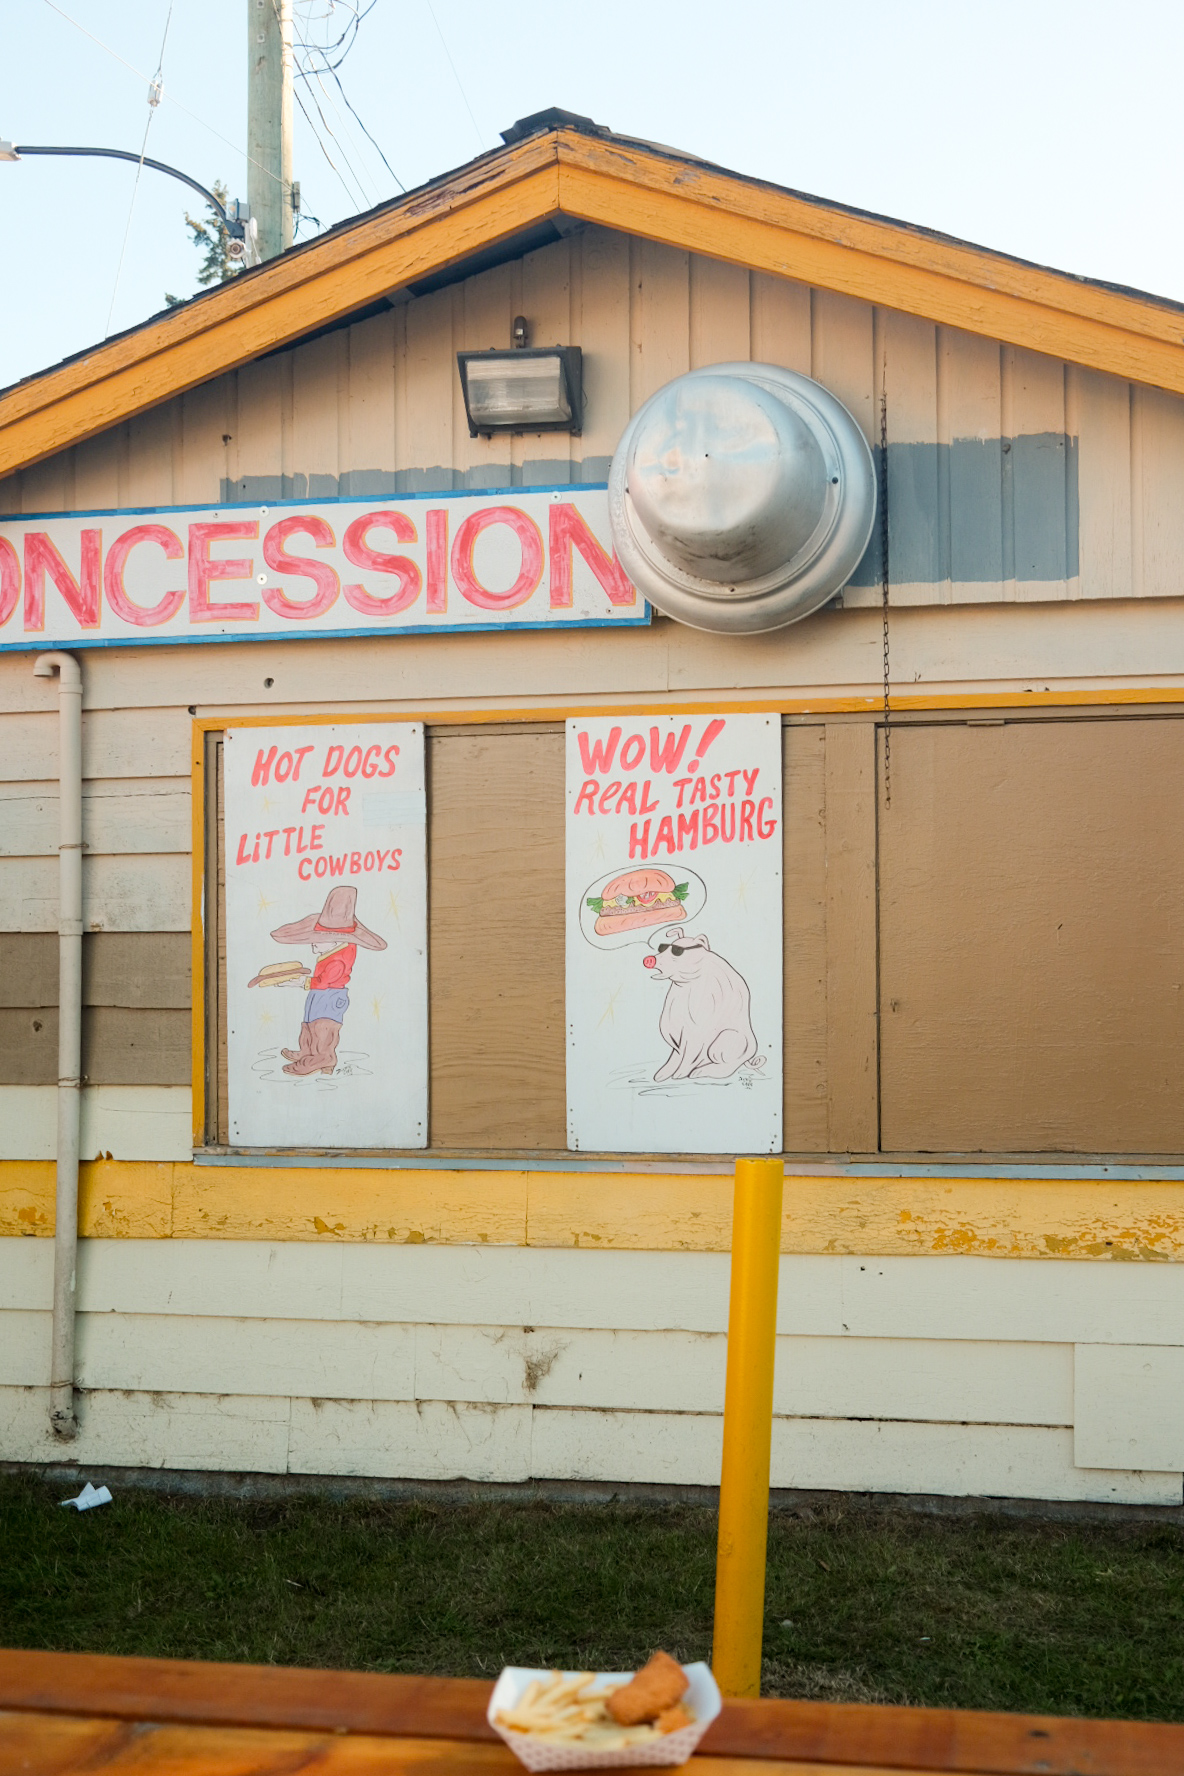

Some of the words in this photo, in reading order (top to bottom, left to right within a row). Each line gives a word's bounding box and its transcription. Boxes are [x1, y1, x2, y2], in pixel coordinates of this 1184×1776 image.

[0, 503, 637, 631] NCESSION
[251, 745, 315, 787] HOT
[322, 744, 400, 779] DOGS
[577, 719, 726, 776] WOW!
[301, 785, 352, 816] FOR
[673, 768, 760, 809] TASTY
[628, 796, 778, 860] HAMBURG
[298, 848, 403, 881] COWBOYS
